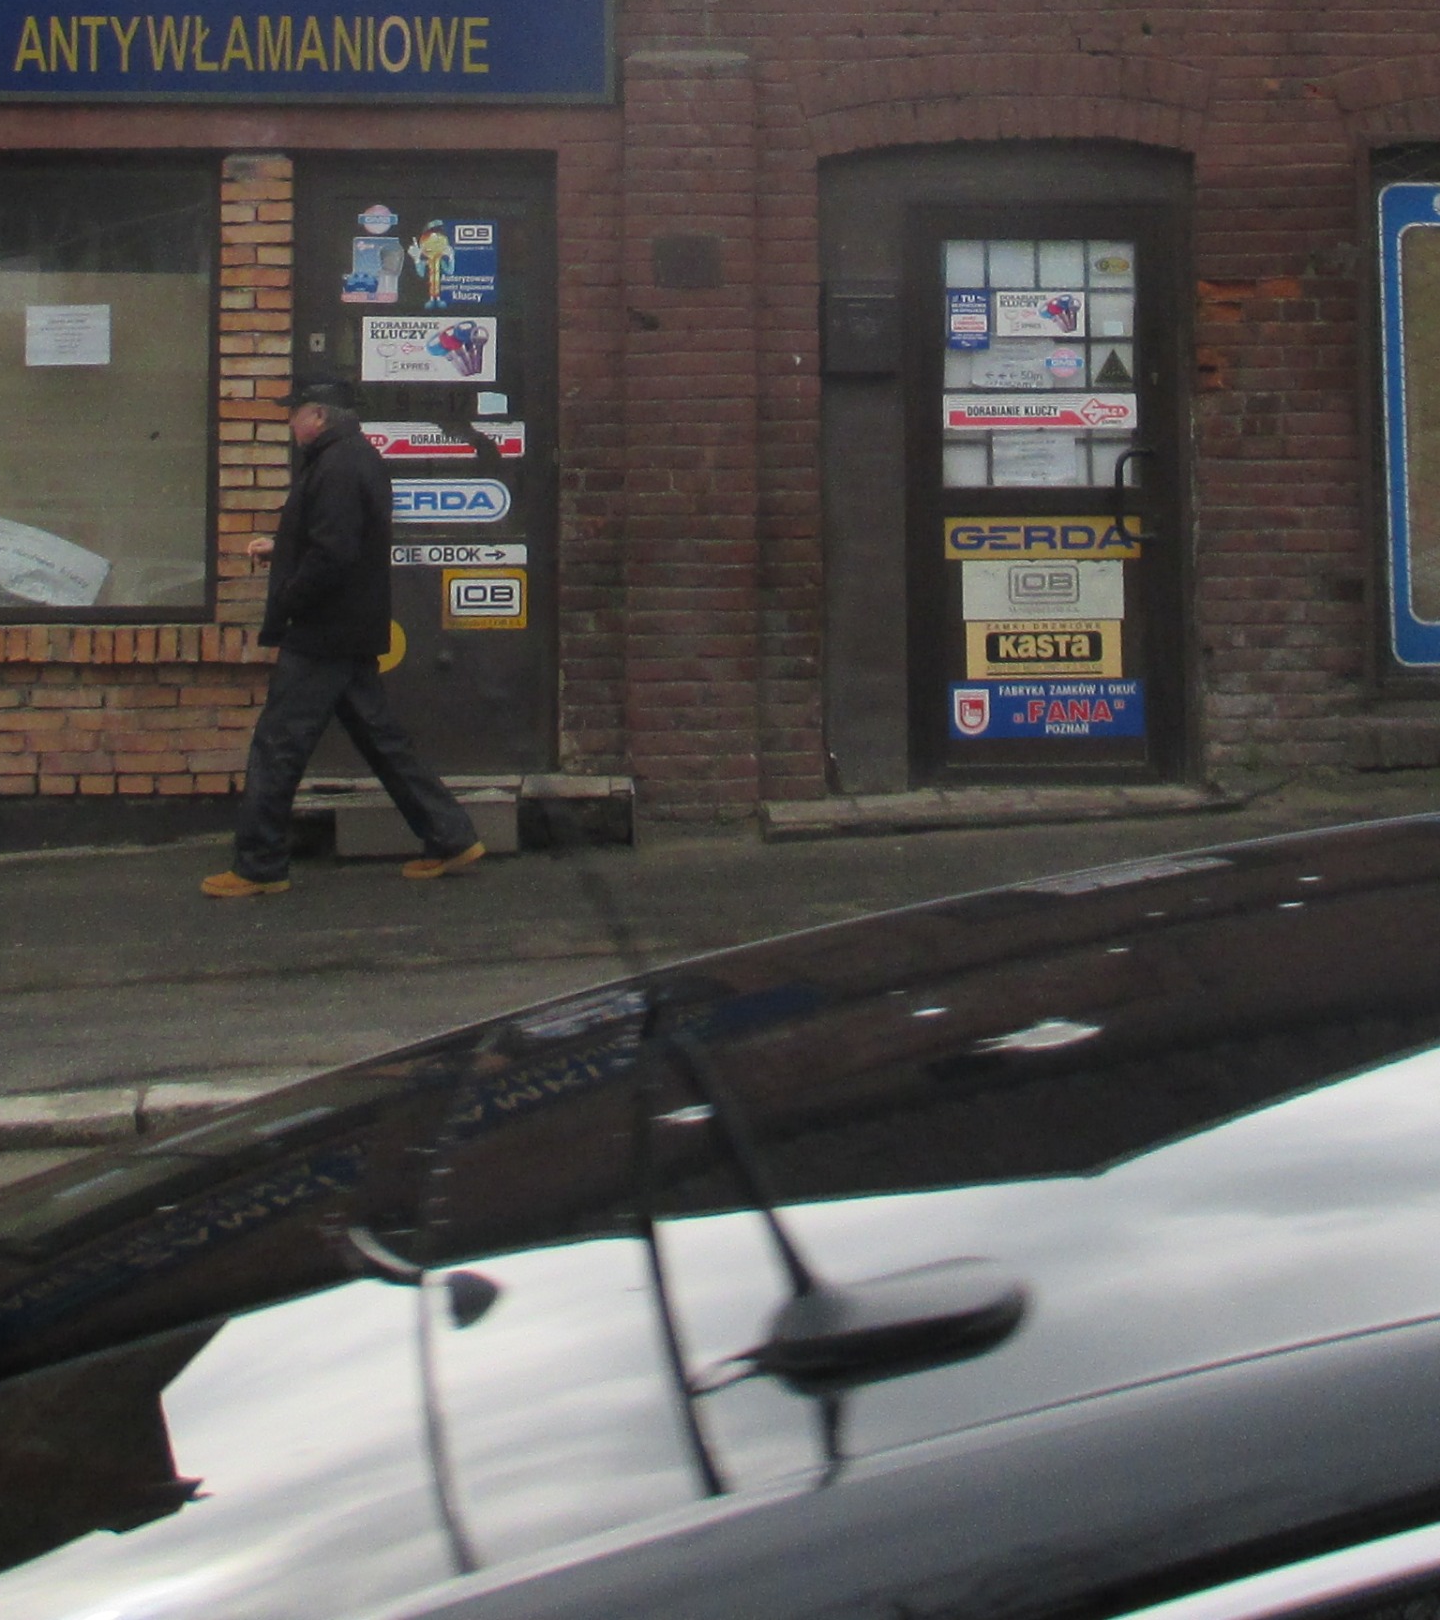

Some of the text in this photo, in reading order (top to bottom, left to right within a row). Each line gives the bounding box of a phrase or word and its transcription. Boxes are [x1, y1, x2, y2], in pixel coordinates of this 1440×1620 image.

[14, 15, 491, 73] ANTYWŁAMANIOWE
[370, 321, 440, 330] DORABIANIE
[370, 329, 428, 340] KLUCZY
[966, 405, 1021, 417] DORABIANIE
[1023, 405, 1059, 417] KLUCZY
[391, 490, 495, 511] ERDA
[949, 524, 1135, 551] GERDA
[428, 546, 482, 563] OBOK
[456, 585, 515, 610] LOB
[998, 685, 1046, 697] FABRYKA
[1049, 683, 1097, 696] ZAMKÓW
[1108, 681, 1137, 696] OKUĆ
[1045, 721, 1090, 735] POZNAŃ
